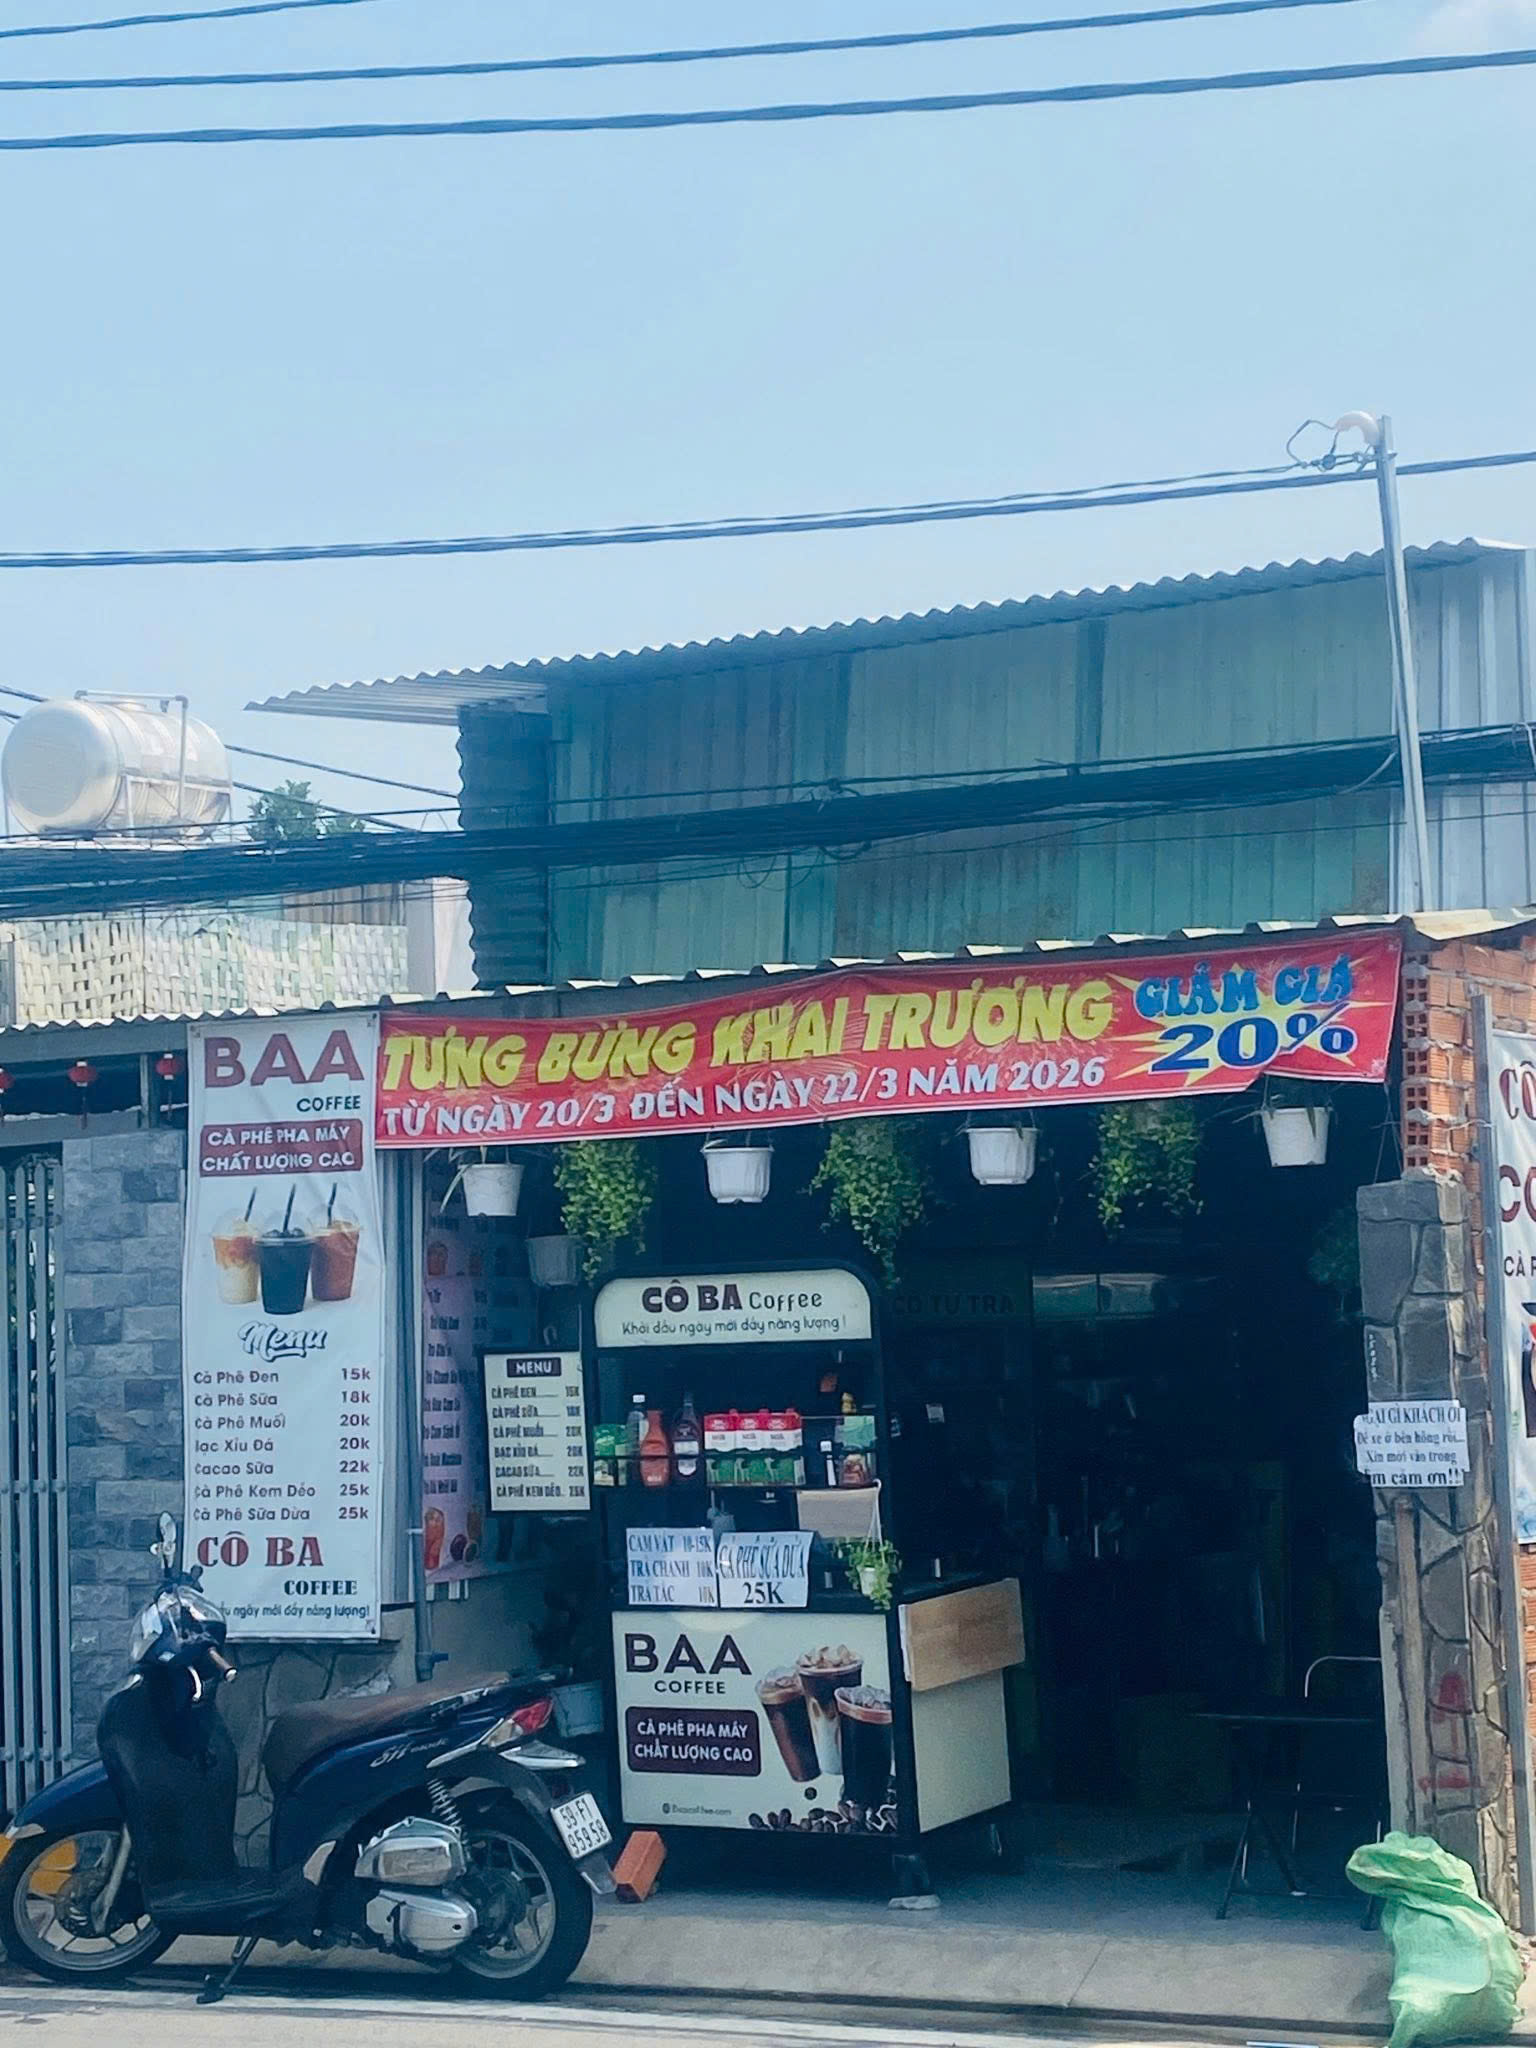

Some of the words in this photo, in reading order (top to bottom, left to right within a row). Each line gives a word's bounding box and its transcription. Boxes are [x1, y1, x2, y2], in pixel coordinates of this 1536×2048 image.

[1134, 960, 1260, 1019] GIẢM
[1274, 953, 1353, 1006] GIÁ
[709, 997, 850, 1067] KHAI
[1149, 1002, 1358, 1072] 20%
[204, 1030, 365, 1088] BAA
[296, 1095, 361, 1112] COFFEE
[383, 1099, 431, 1136] TỪ
[436, 1096, 530, 1134] NGÀY
[536, 1093, 616, 1127] 20/3
[629, 1080, 704, 1120] ĐẾN
[716, 1070, 817, 1113] NGÀY
[822, 1066, 898, 1104] 22/3
[907, 1058, 998, 1097] NĂM
[1006, 1056, 1107, 1091] 2026
[208, 1128, 236, 1146] CÀ
[240, 1126, 273, 1145] PHÊ
[277, 1128, 310, 1144] PHA
[316, 1122, 351, 1142] MÁY
[202, 1151, 252, 1172] CHẤT
[255, 1152, 313, 1172] LƯỢNG
[319, 1151, 355, 1167] CAO
[1504, 1250, 1526, 1277] CÀ
[641, 1279, 689, 1314] CÔ
[697, 1284, 743, 1311] BA
[749, 1292, 823, 1312] Coffee
[679, 1321, 712, 1336] ngày
[238, 1320, 328, 1362] Menu
[194, 1370, 212, 1384] Cà
[217, 1370, 244, 1384] Phê
[250, 1370, 279, 1383] Đen
[341, 1367, 371, 1380] 15k
[516, 1361, 552, 1374] MENU
[194, 1393, 213, 1406] Cà
[218, 1392, 245, 1406] Phê
[250, 1392, 277, 1405] Sữa
[341, 1391, 371, 1403] 18k
[194, 1416, 212, 1429] Cà
[218, 1415, 245, 1429] Phê
[250, 1413, 286, 1428] Muối
[339, 1414, 370, 1426] 20k
[1388, 1403, 1402, 1424] GÌ
[1403, 1403, 1444, 1424] KHÁCH
[253, 1438, 274, 1451] Đá
[339, 1437, 370, 1450] 20k
[194, 1463, 240, 1474] Cacao
[246, 1461, 274, 1475] Sữa
[339, 1460, 370, 1473] 22k
[216, 1484, 243, 1497] Phê
[249, 1485, 282, 1497] Kem
[287, 1482, 316, 1497] Dẻo
[339, 1483, 370, 1496] 25k
[216, 1506, 242, 1521] Phê
[248, 1507, 275, 1520] Sữa
[281, 1505, 310, 1520] Dừa
[338, 1507, 369, 1519] 25k
[197, 1531, 249, 1567] CÔ
[265, 1537, 324, 1567] BA
[629, 1535, 652, 1552] CAM
[652, 1560, 690, 1577] CHANH
[284, 1580, 358, 1595] COFFEE
[743, 1582, 785, 1604] 25K
[624, 1633, 752, 1676] BAA
[654, 1680, 726, 1694] COFFEE
[637, 1718, 656, 1735] CÀ
[658, 1718, 685, 1737] PHÊ
[687, 1722, 716, 1738] PHA
[718, 1720, 748, 1738] MÁY
[672, 1744, 720, 1763] LƯỢNG
[723, 1746, 753, 1762] CAO
[568, 1819, 608, 1855] 959.58
